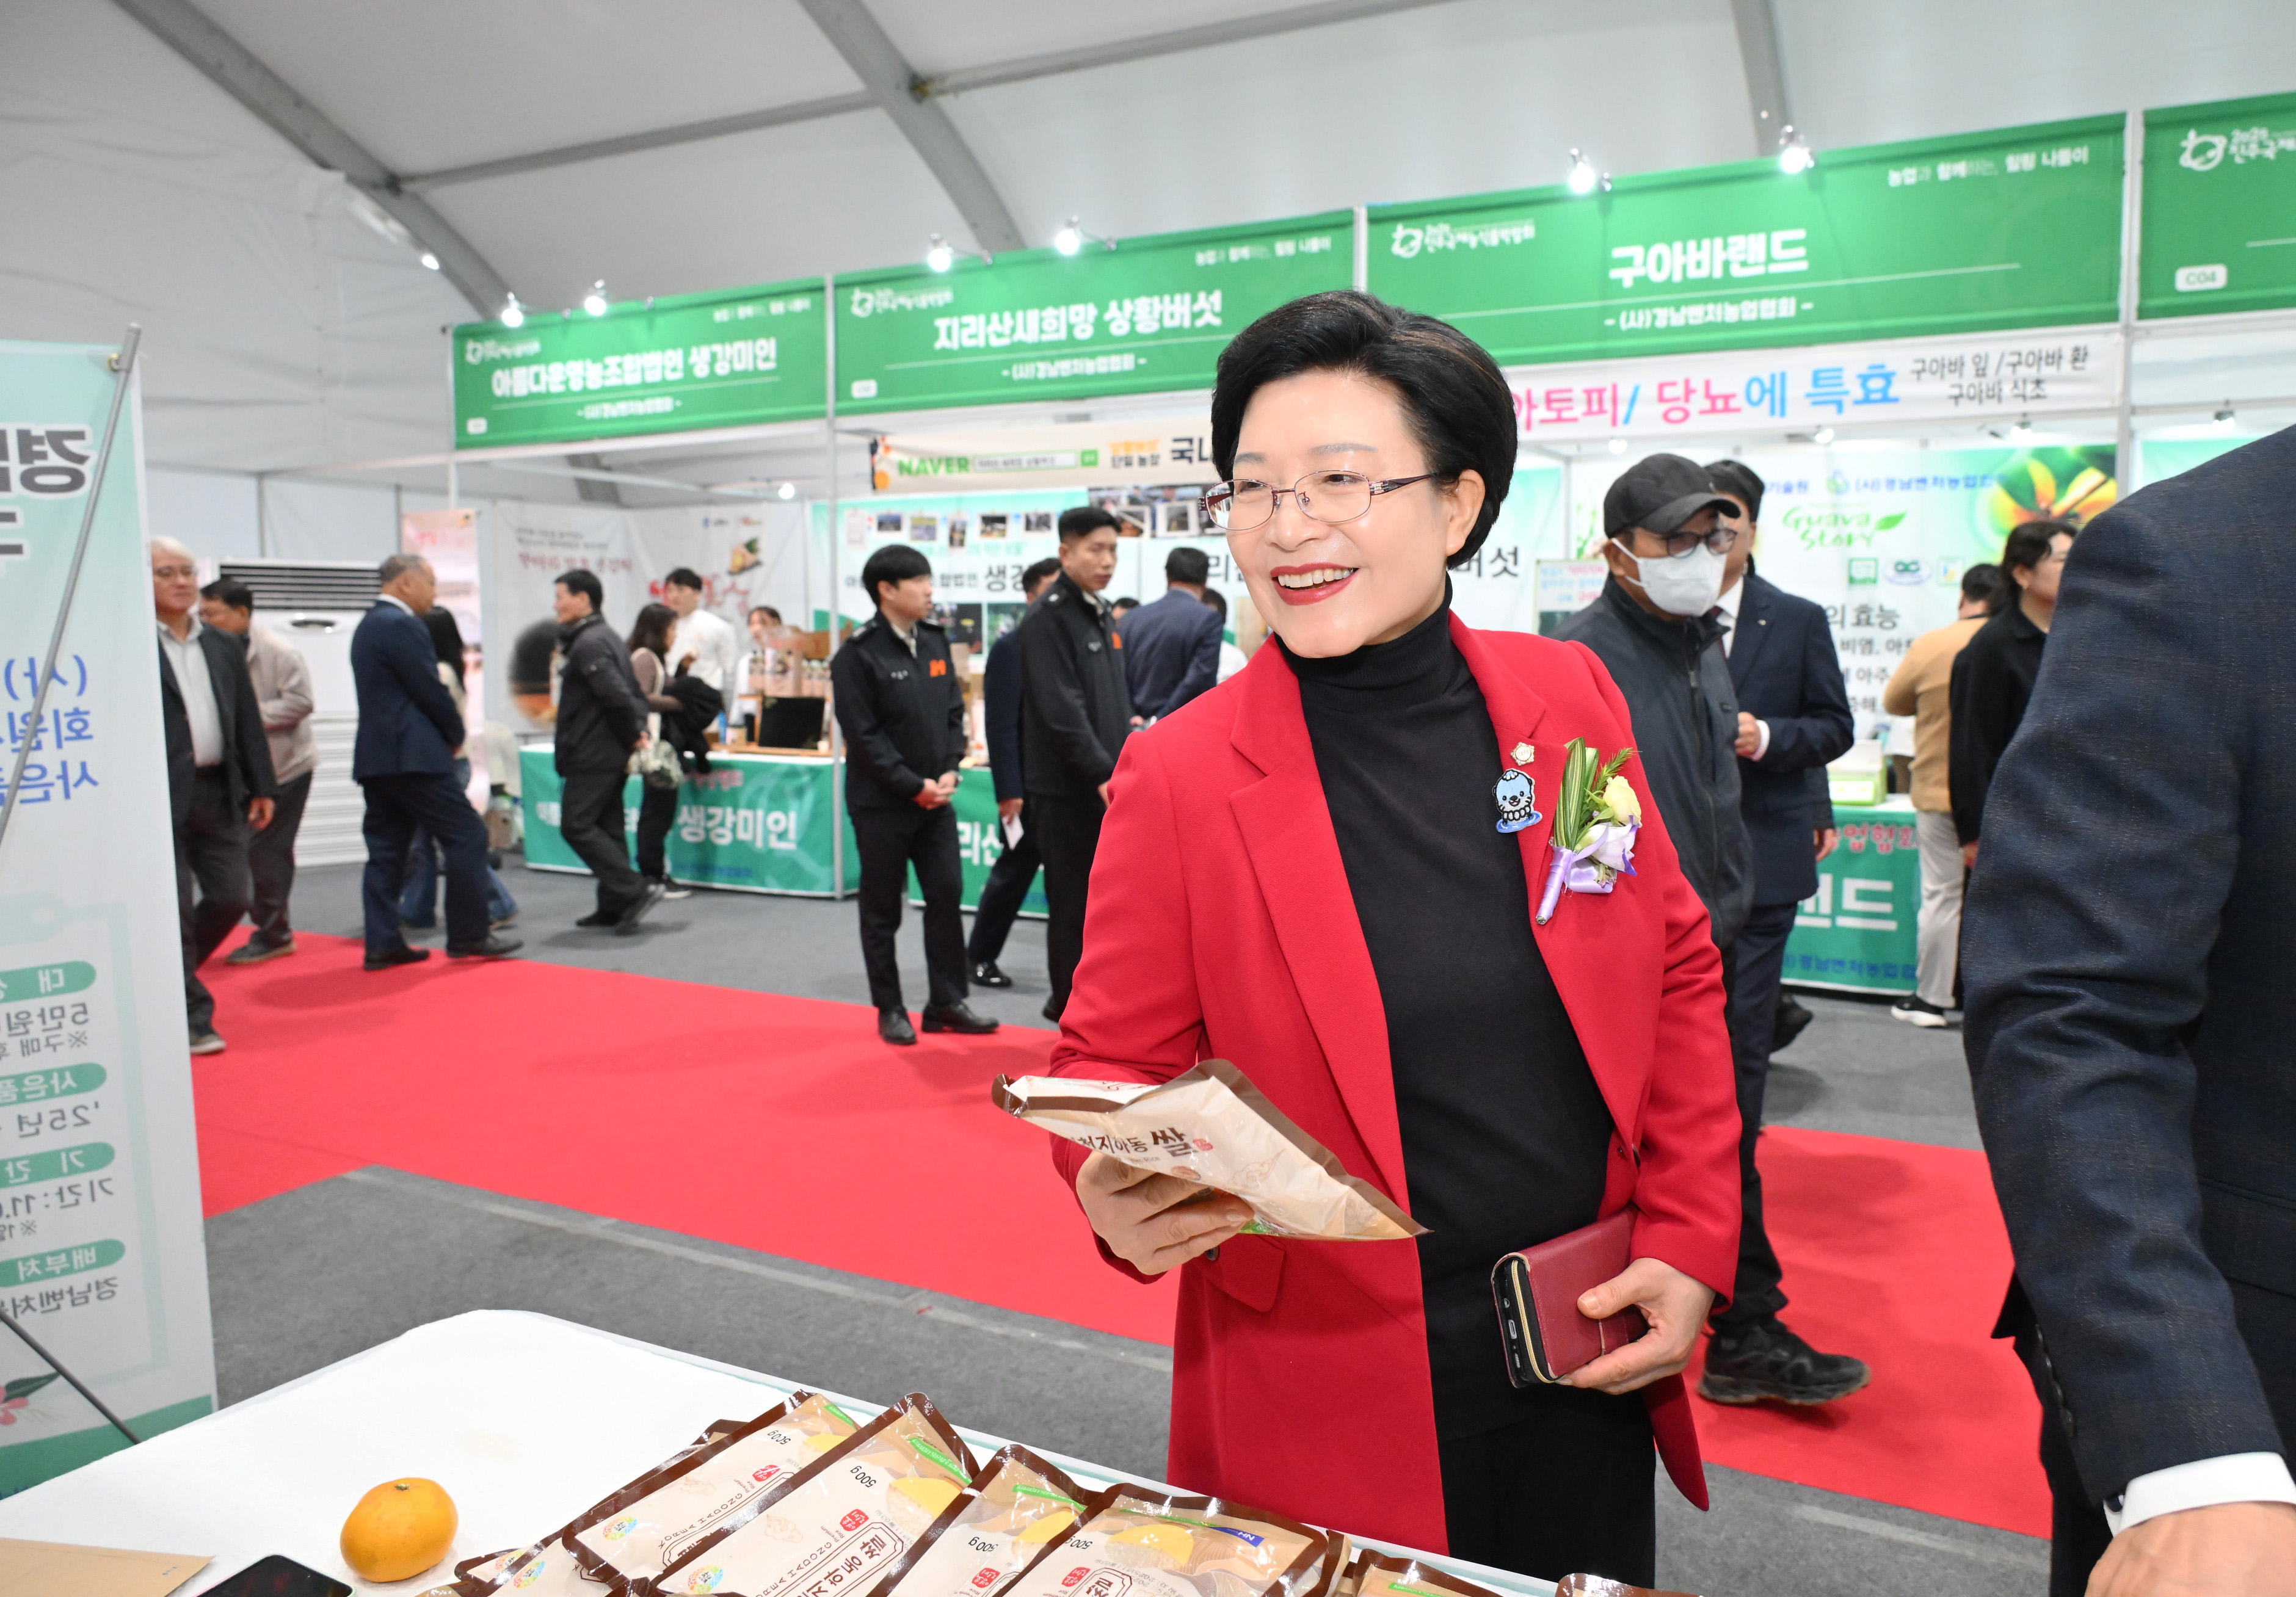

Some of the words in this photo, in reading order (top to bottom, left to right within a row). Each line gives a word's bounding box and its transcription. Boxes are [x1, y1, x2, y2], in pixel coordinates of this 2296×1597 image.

[1609, 229, 1809, 289] 구아바랜드
[934, 307, 1097, 350] 지리산새희망
[1103, 289, 1222, 335] 상황버섯
[688, 337, 777, 378] 생강미인
[1910, 358, 1965, 381] 구아바
[1971, 353, 1989, 377] 잎
[2069, 346, 2089, 373] 환
[1657, 371, 1786, 424] 당뇨에
[1804, 363, 1900, 415] 특효
[1947, 382, 2003, 407] 구아바
[2011, 377, 2048, 403] 식초
[898, 455, 970, 478] NAVER
[1782, 505, 1871, 531] Guava
[676, 805, 799, 851] 생강미인
[1150, 1127, 1199, 1157] 쌀
[747, 1481, 756, 1490] Rice
[658, 1524, 697, 1549] KOREA
[698, 1493, 743, 1524] HADONG
[820, 1526, 840, 1543] Premium
[835, 1530, 845, 1539] Rice
[1238, 1530, 1255, 1541] NH
[787, 1542, 832, 1578] HADONG
[860, 1534, 887, 1560] 쌀
